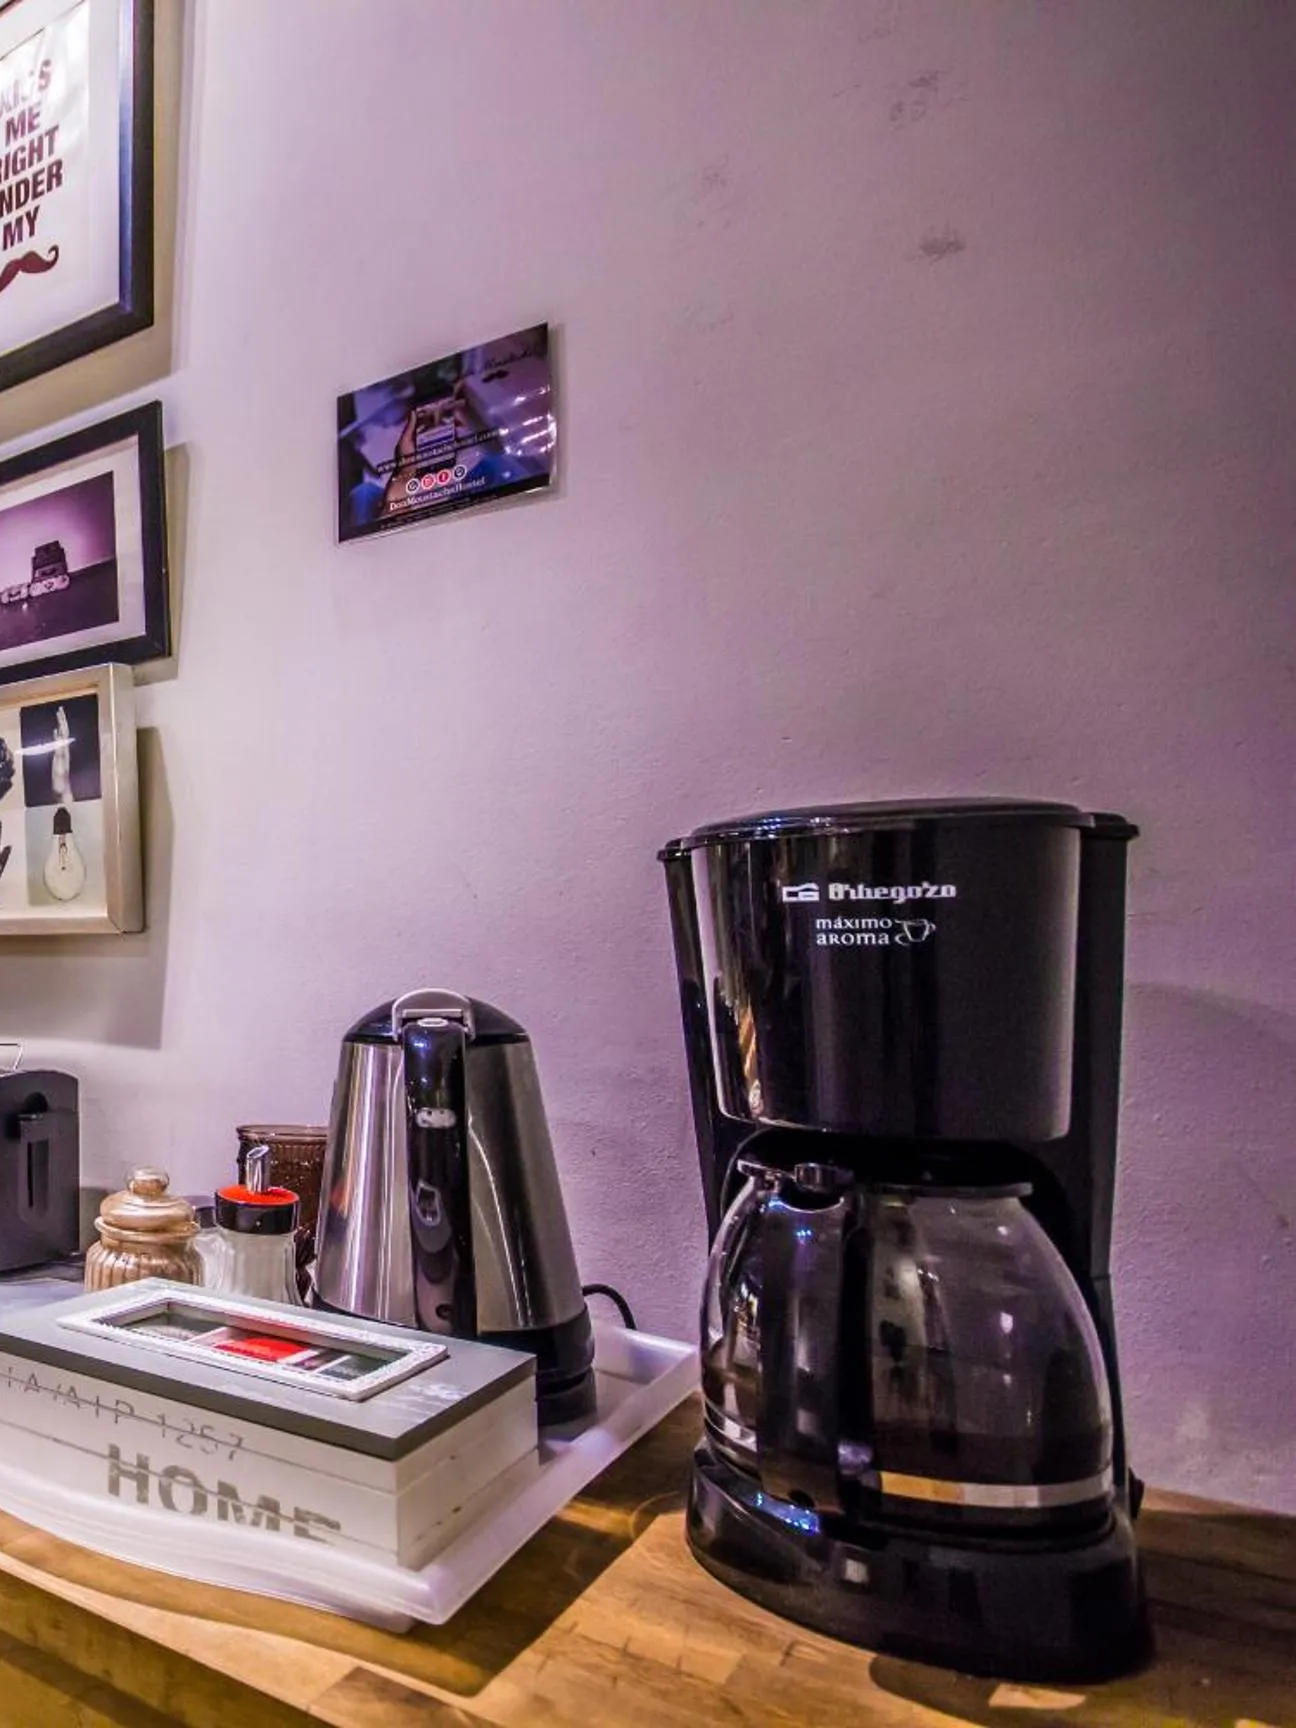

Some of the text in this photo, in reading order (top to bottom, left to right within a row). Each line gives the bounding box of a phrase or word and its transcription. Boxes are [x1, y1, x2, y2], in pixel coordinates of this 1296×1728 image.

[5, 106, 41, 148] ME
[2, 204, 41, 252] MY
[107, 1443, 342, 1543] HOME
